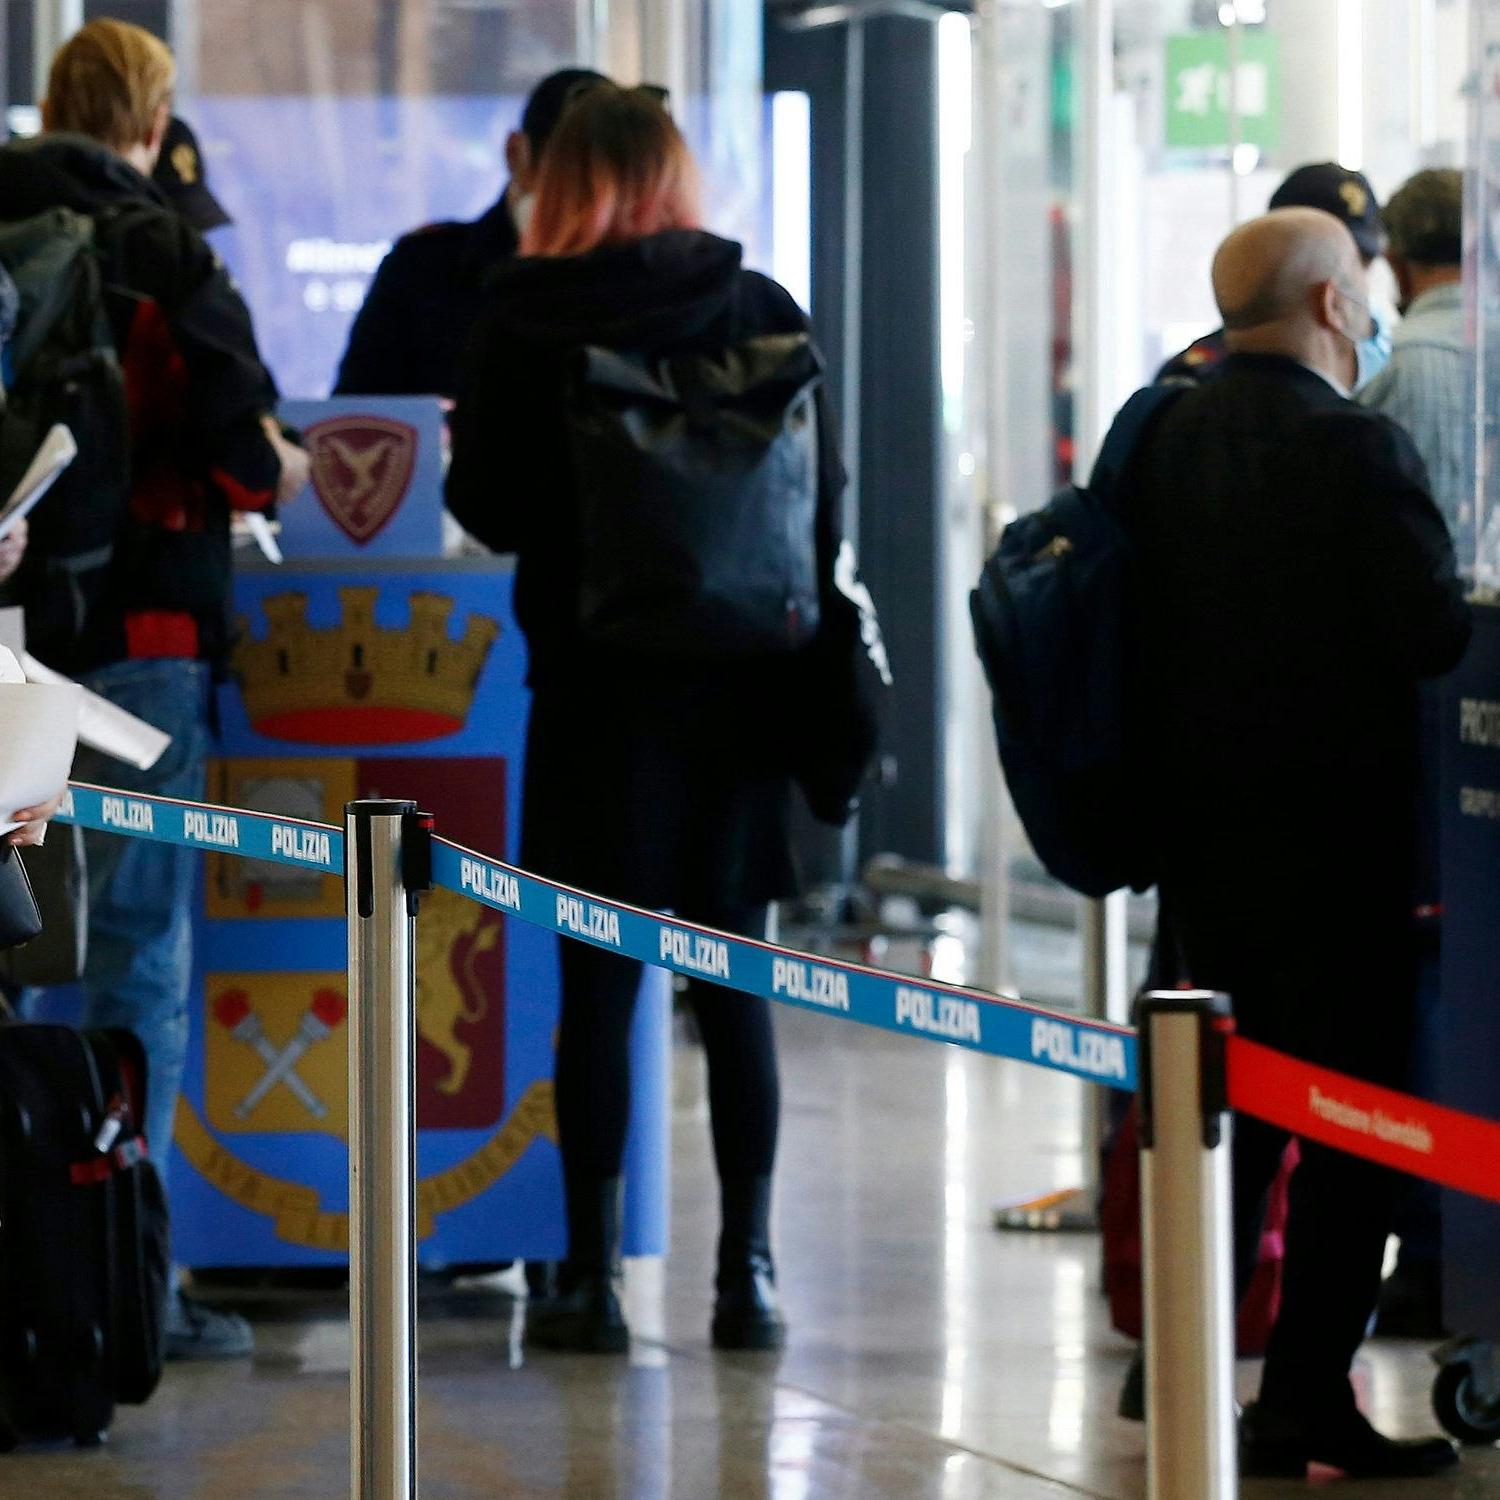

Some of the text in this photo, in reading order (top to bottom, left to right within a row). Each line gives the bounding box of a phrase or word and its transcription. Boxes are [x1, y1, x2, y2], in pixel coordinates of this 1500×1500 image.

[102, 796, 154, 832] POLIZIA
[184, 809, 239, 848] POLIZIA
[271, 824, 330, 866] POLIZIA
[460, 857, 1127, 1081] POLIZIA POLIZIA POLIZIA POLIZIA POLIZIA POLIZIA
